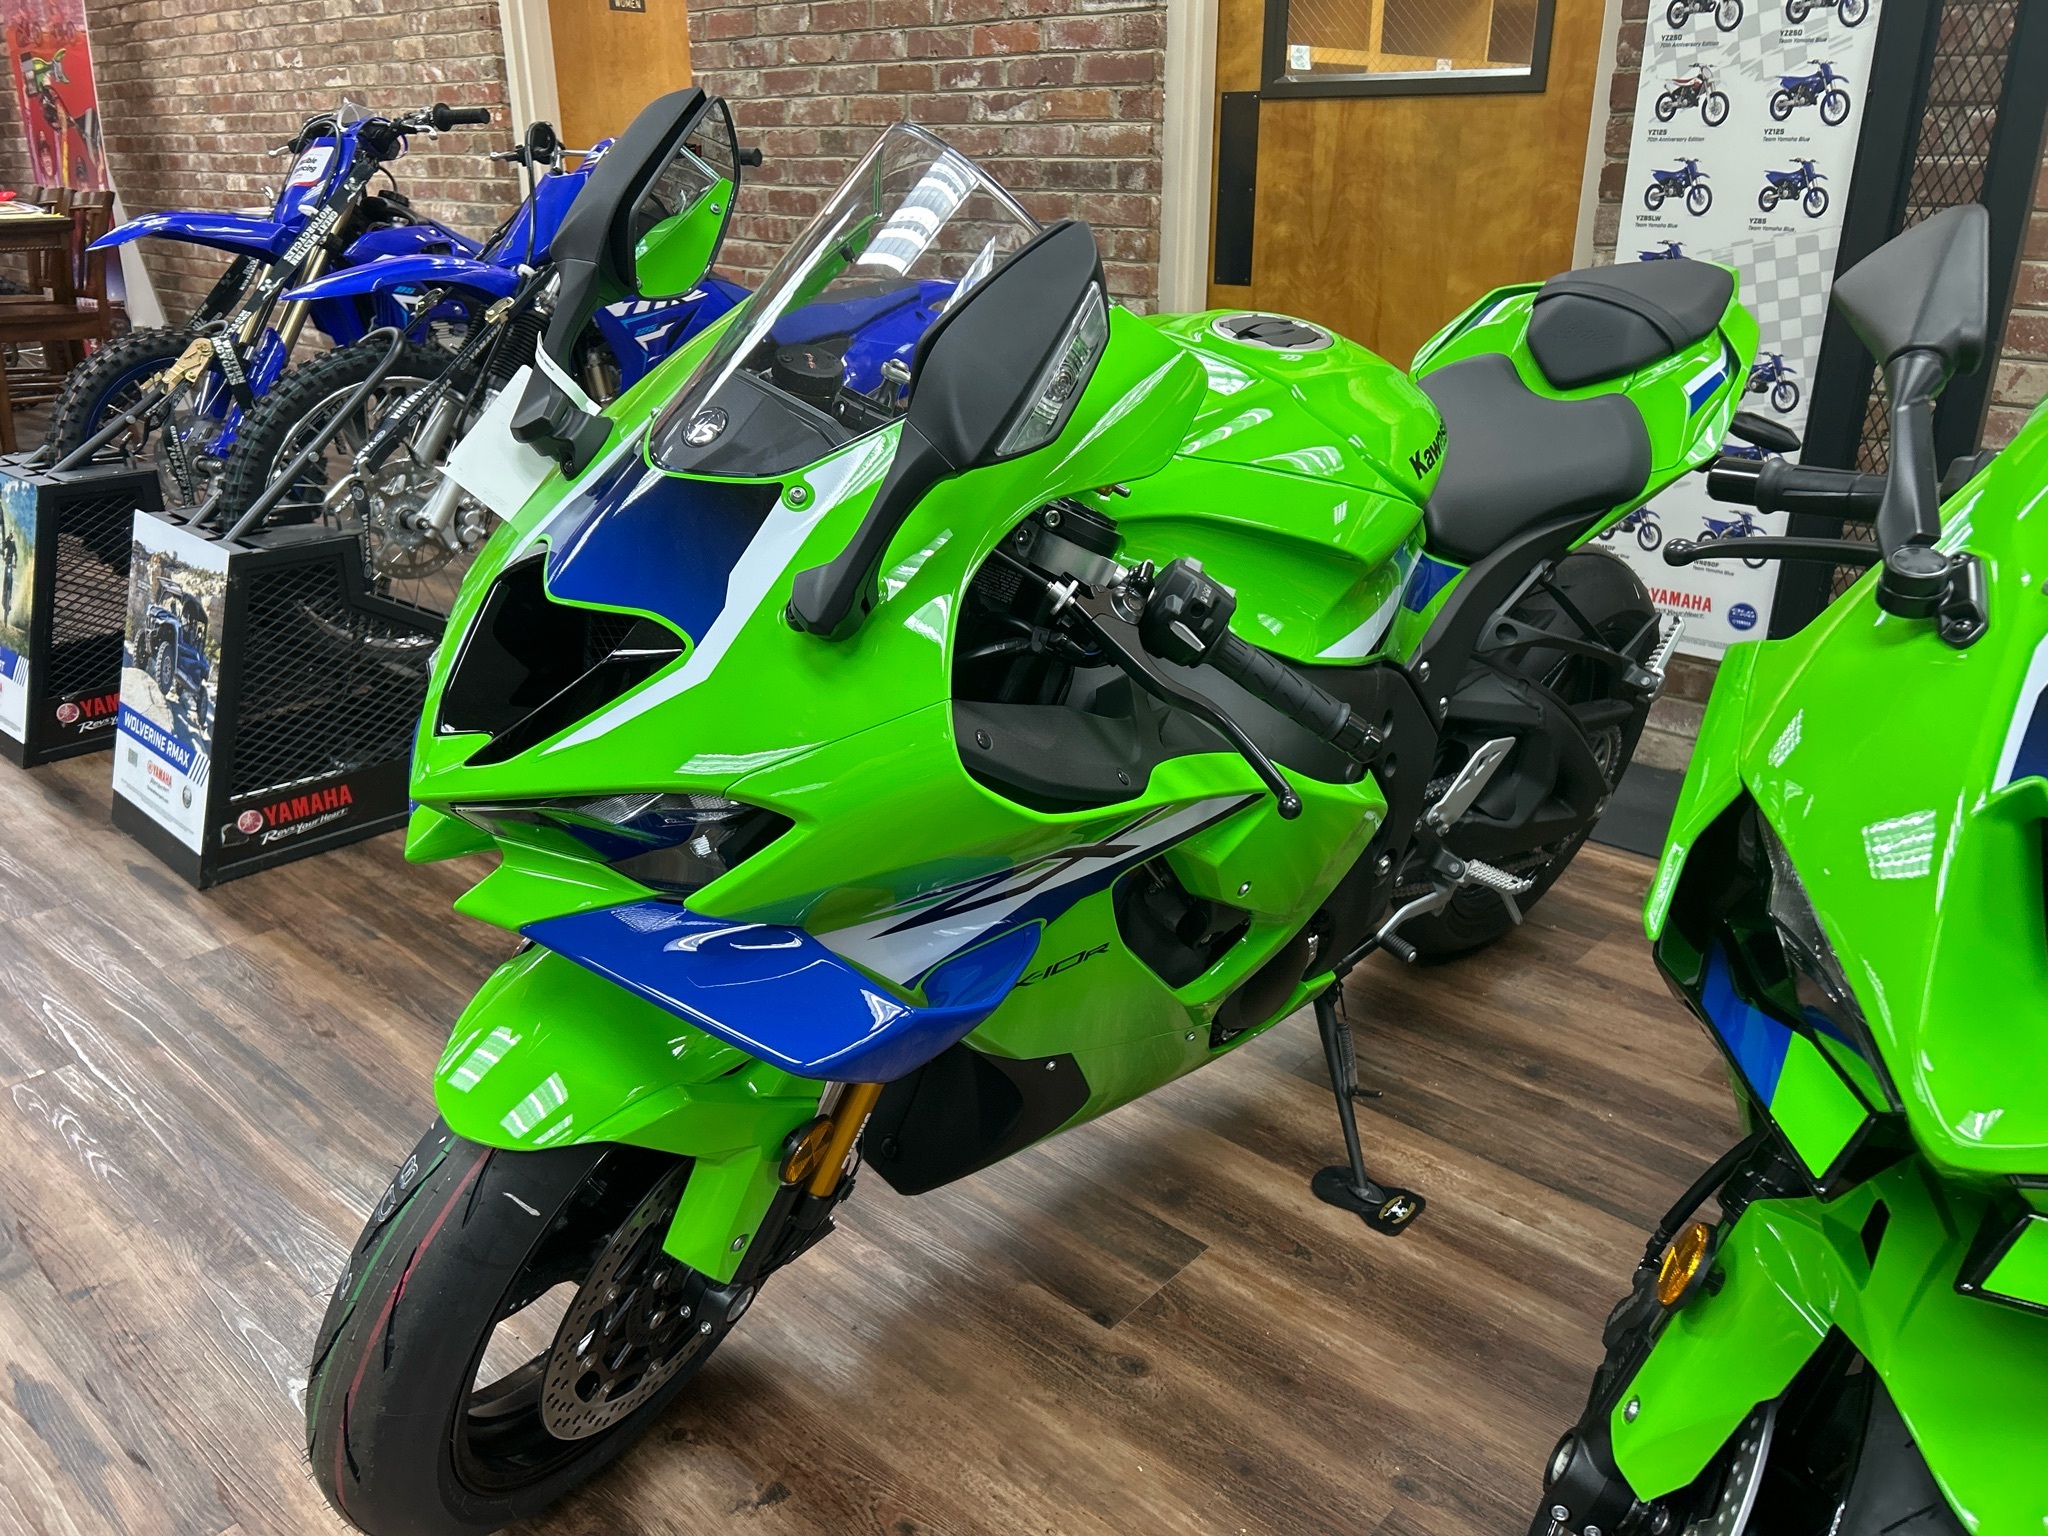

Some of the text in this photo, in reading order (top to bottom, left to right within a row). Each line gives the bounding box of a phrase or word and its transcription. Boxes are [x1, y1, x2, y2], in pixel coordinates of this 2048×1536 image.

[283, 205, 333, 261] MOTORCYCLES
[289, 210, 339, 267] GREAT WESTERN
[417, 378, 452, 415] YAMAHA
[1651, 587, 1712, 613] YAMAHA
[80, 693, 119, 717] YAM
[124, 711, 190, 769] WOLVERINE RMAX
[152, 766, 173, 789] YAMAHA
[263, 784, 353, 827] YAMAHA
